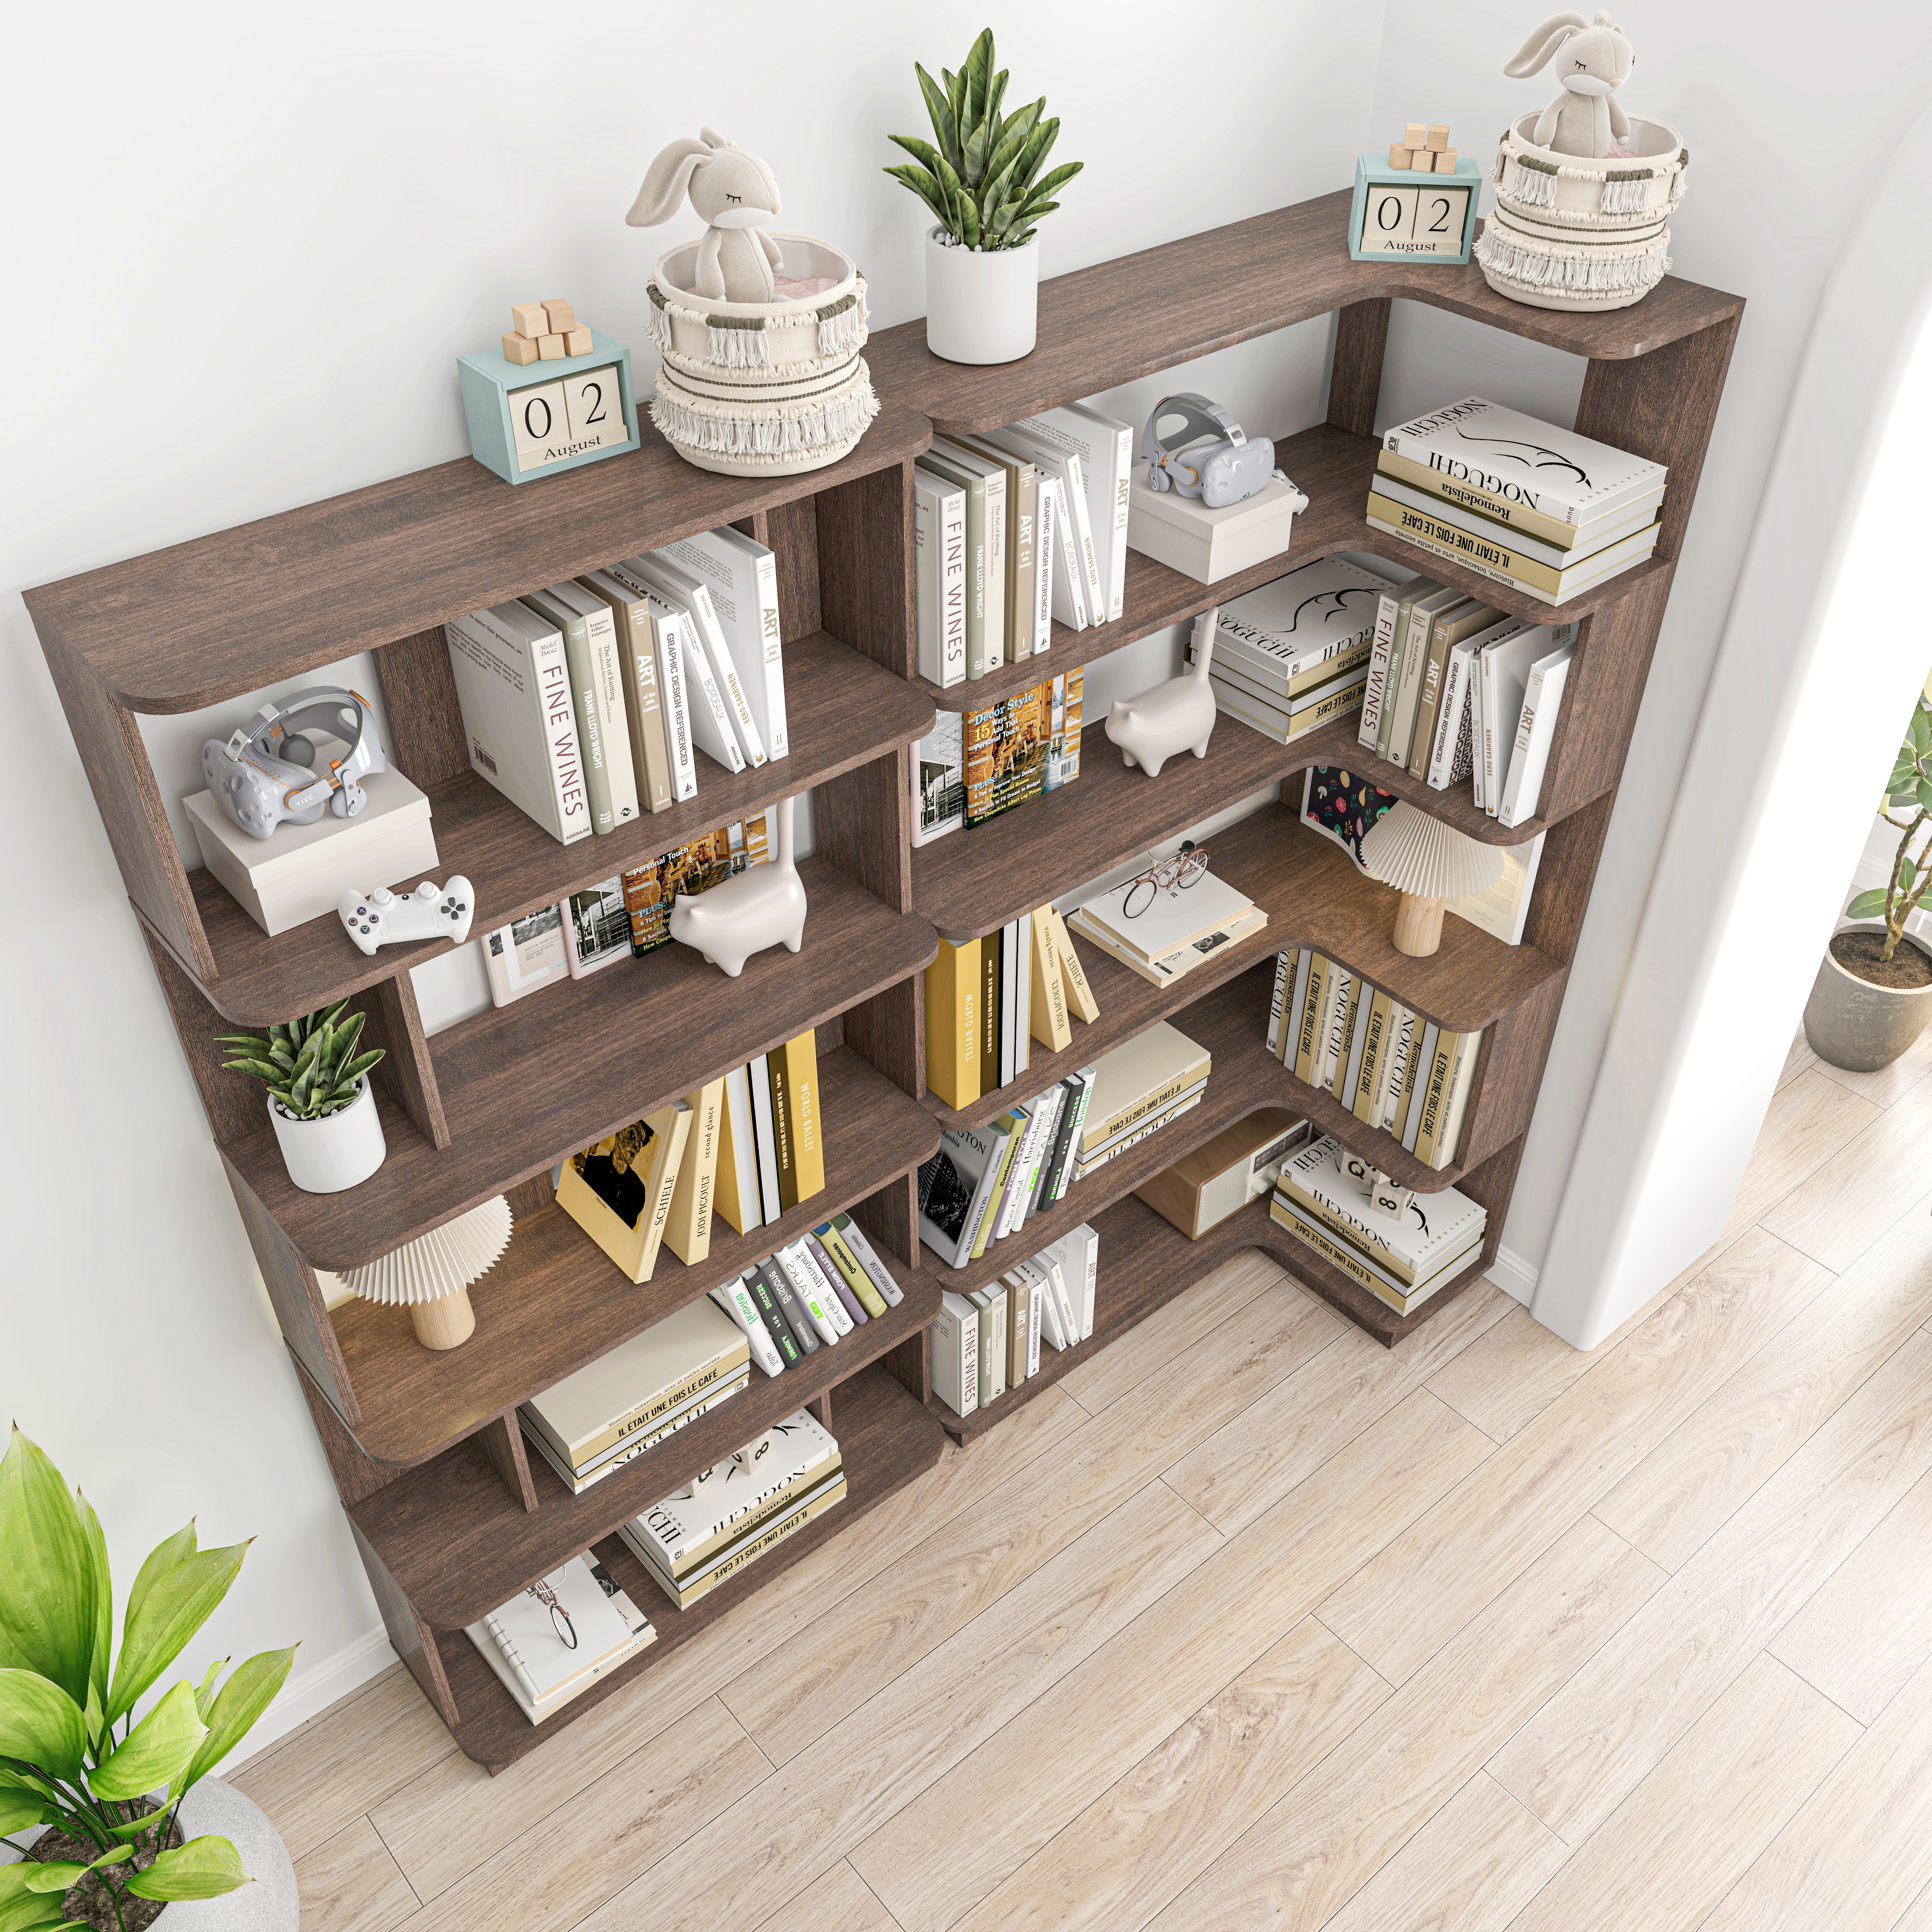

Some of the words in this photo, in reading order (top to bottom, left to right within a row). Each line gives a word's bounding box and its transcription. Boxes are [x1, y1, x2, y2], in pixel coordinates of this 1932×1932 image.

[1378, 197, 1402, 230] 0
[1428, 199, 1450, 232] 2
[1383, 241, 1436, 253] August
[525, 398, 551, 439] 0
[582, 383, 607, 425] 2
[1400, 400, 1488, 436] NOGUCHI
[543, 436, 602, 461] August
[1117, 478, 1129, 507] ART
[1428, 452, 1540, 510] NOGUCHI
[1442, 483, 1511, 520] Remodelista
[1021, 516, 1032, 544] ART
[1401, 511, 1423, 530] CAFÉ
[1424, 521, 1435, 534] LE
[1436, 526, 1454, 544] FOIS
[948, 521, 961, 576] FINE
[1395, 530, 1416, 542] secrets
[1417, 540, 1434, 551] petits
[1456, 535, 1474, 551] UNE
[1065, 541, 1078, 582] BORDEAUX
[1084, 537, 1096, 568] SAARINEN
[1442, 550, 1454, 559] arts
[1457, 555, 1486, 573] botanique,
[1475, 543, 1500, 566] ÉTAIT
[1502, 554, 1510, 568] IL
[1088, 569, 1097, 585] EERO
[1489, 569, 1514, 586] Histoire,
[700, 594, 711, 618] ASSOULINE
[590, 619, 608, 627] Françoise
[591, 627, 611, 638] Loumagne
[764, 609, 778, 638] ART
[948, 583, 962, 661] WINES
[540, 639, 557, 652] Michel
[541, 648, 557, 657] Dovaz
[667, 633, 678, 674] GRAPHIC
[1374, 619, 1392, 664] FINE
[638, 655, 655, 686] ART
[1426, 658, 1440, 688] ART
[1449, 662, 1459, 694] GRAPHIC
[543, 665, 569, 725] FINE
[583, 690, 595, 715] FRANK
[671, 675, 682, 709] DESIGN
[705, 678, 725, 721] BORDEAUX
[727, 673, 743, 706] SAARINEN
[1364, 670, 1384, 730] WINES
[643, 703, 659, 713] Century
[740, 707, 750, 724] EERO
[975, 706, 1005, 725] Decor
[1008, 693, 1034, 711] Style
[992, 716, 1007, 726] Ways
[1443, 694, 1453, 720] DESIGN
[1520, 705, 1534, 734] ART
[587, 715, 598, 739] LLOYD
[675, 710, 688, 766] REFERENCED
[975, 723, 990, 742] 15
[975, 734, 1001, 751] Personal
[1003, 725, 1020, 738] Touch
[992, 724, 1003, 735] Add
[1006, 718, 1018, 728] That
[1435, 719, 1449, 763] REFERENCED
[592, 739, 603, 769] WRIGHT
[731, 747, 740, 766] ASSOULINE
[555, 732, 583, 816] WINES
[975, 777, 996, 791] PLUS:
[994, 779, 1010, 790] Improve
[1022, 767, 1036, 776] Design
[1000, 784, 1014, 794] Special
[1015, 778, 1029, 787] Rooms
[295, 794, 314, 807] VIVE
[979, 802, 994, 813] Secrets
[1007, 789, 1020, 799] Dream
[1026, 779, 1041, 789] Budget
[985, 804, 1006, 817] Chopsticks
[1007, 797, 1020, 806] Affect
[1029, 787, 1041, 796] Prices
[566, 827, 590, 840] ASSOULINE
[526, 949, 540, 957] Selected
[540, 934, 559, 945] PORFOLIO
[1329, 974, 1351, 1058] NOGUCHI
[1343, 1001, 1358, 1052] Remodelista
[1389, 1014, 1415, 1098] NOGUCHI
[1405, 1040, 1421, 1093] Remodelista
[800, 1081, 811, 1118] WORLD
[1075, 1086, 1092, 1128] Houston
[803, 1119, 814, 1151] BALLET
[1023, 1109, 1046, 1164] Harrisburg
[1048, 1100, 1065, 1146] Brisbane
[1000, 1136, 1020, 1187] Contemporan
[1007, 1163, 1019, 1191] FORM
[1016, 1132, 1029, 1164] STYLE
[1050, 1167, 1062, 1200] FORMULA
[1068, 1095, 1081, 1128] SUCCESS
[1348, 1161, 1365, 1180] Q
[655, 1175, 675, 1225] SCHIELE
[699, 1175, 710, 1214] PICOULT
[1378, 1196, 1397, 1211] 8
[697, 1216, 706, 1237] JODI
[965, 1196, 988, 1253] WASHINGTON
[965, 1327, 975, 1359] FINE
[965, 1360, 975, 1403] WINES
[618, 1428, 626, 1437] IL
[627, 1411, 649, 1432] ÉTAIT
[652, 1401, 667, 1417] UNE
[669, 1389, 686, 1406] FOIS
[687, 1382, 697, 1394] LE
[698, 1367, 718, 1387] CAFÉ
